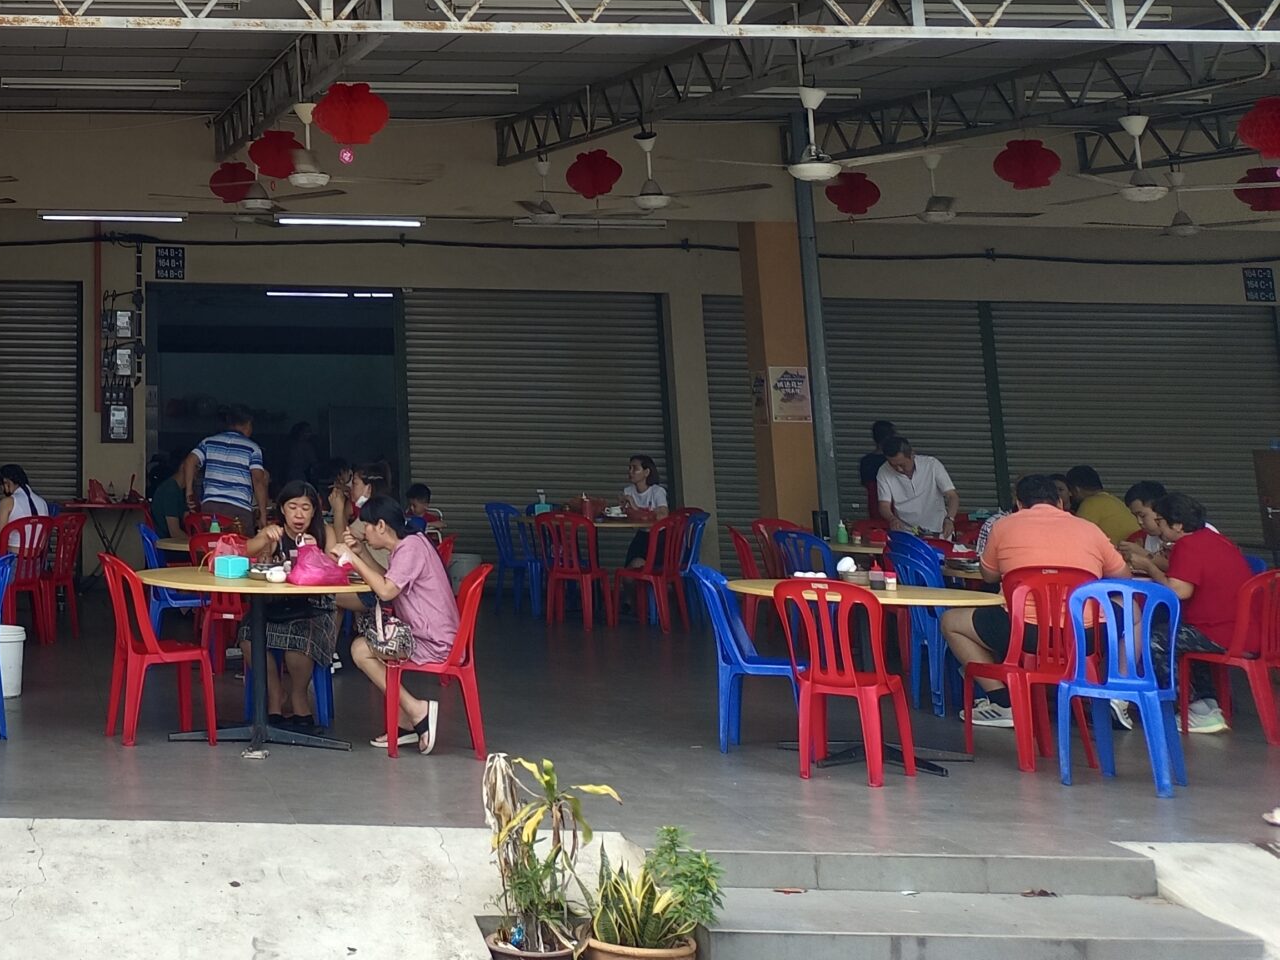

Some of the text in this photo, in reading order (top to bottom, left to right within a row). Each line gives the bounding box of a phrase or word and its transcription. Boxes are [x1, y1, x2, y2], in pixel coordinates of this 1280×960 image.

[158, 248, 169, 257] 164
[158, 258, 169, 267] 164
[157, 269, 169, 278] 164
